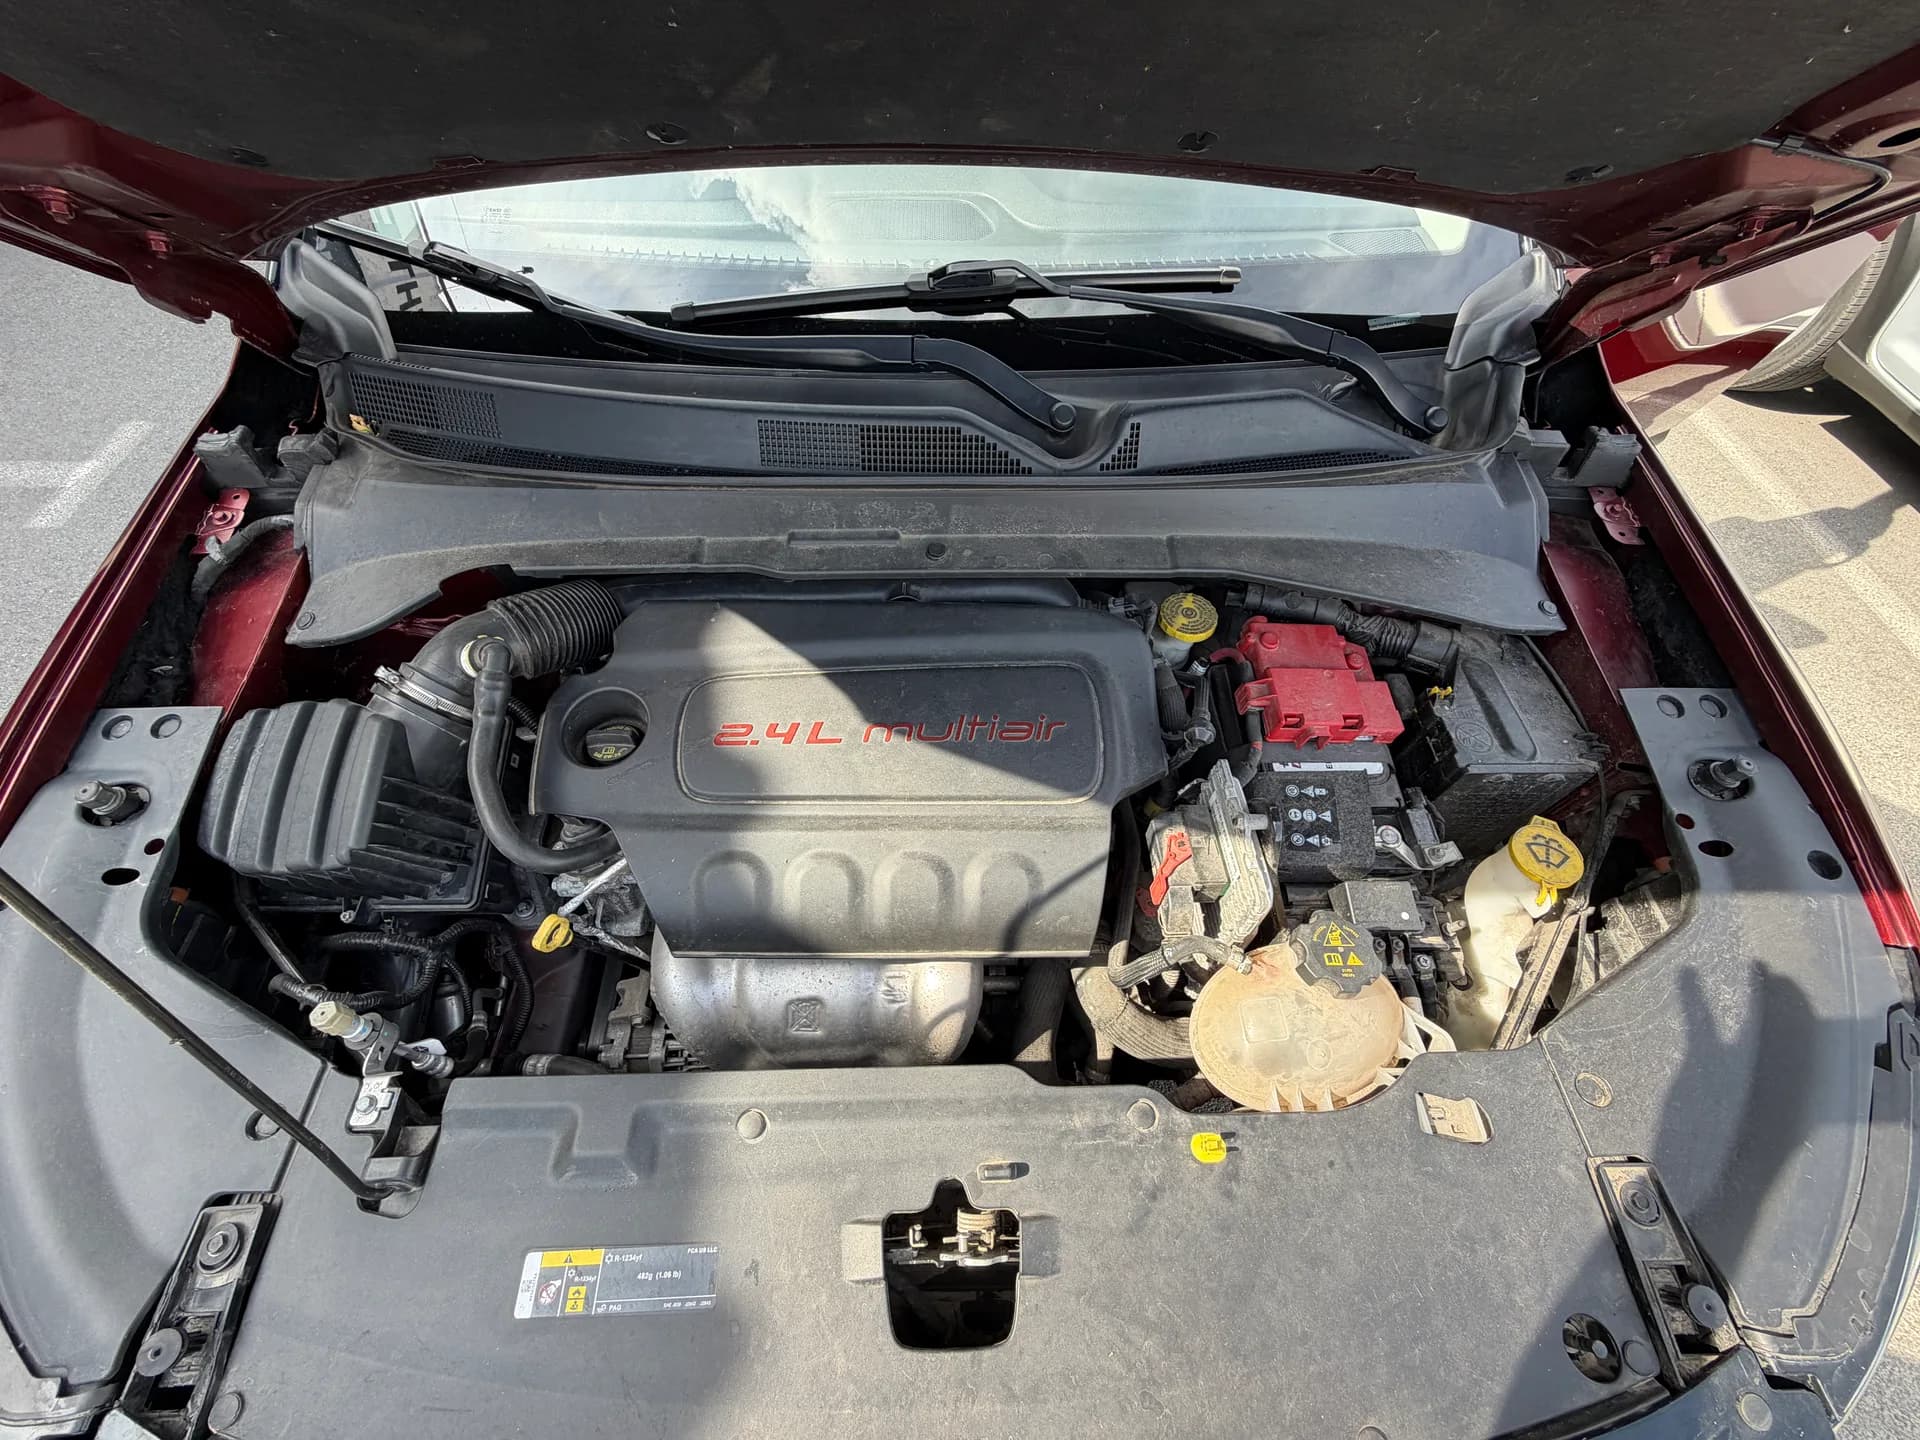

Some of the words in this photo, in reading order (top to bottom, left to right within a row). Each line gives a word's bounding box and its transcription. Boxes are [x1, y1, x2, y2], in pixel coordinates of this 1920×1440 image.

[713, 721, 842, 746] 2.4L
[863, 713, 1066, 744] multiair
[614, 1254, 643, 1264] R-1234yf
